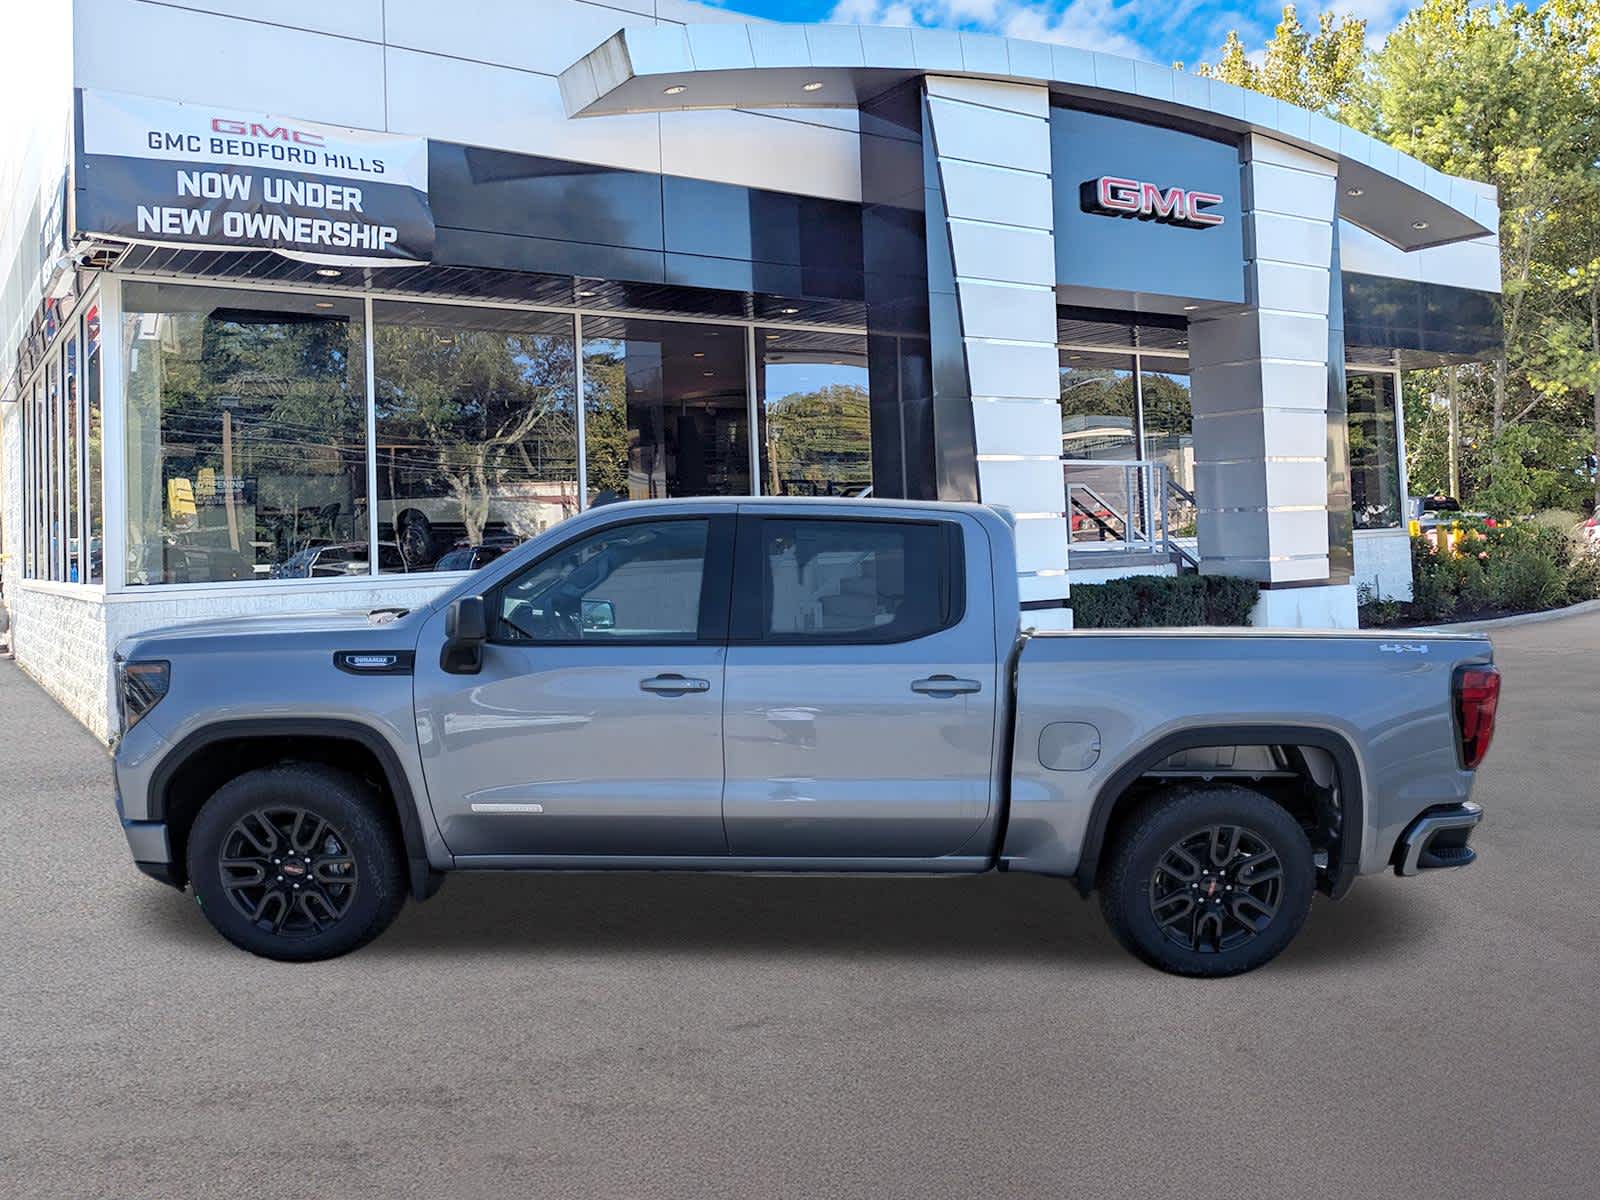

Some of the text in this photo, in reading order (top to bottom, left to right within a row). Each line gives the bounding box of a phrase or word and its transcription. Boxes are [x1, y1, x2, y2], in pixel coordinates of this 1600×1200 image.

[148, 131, 385, 174] GMC BEDFORD HILLS
[211, 118, 326, 148] GMC
[176, 170, 364, 213] NOW UNDER
[1097, 175, 1225, 224] GMC
[136, 206, 398, 250] NEW OWNERSHIP
